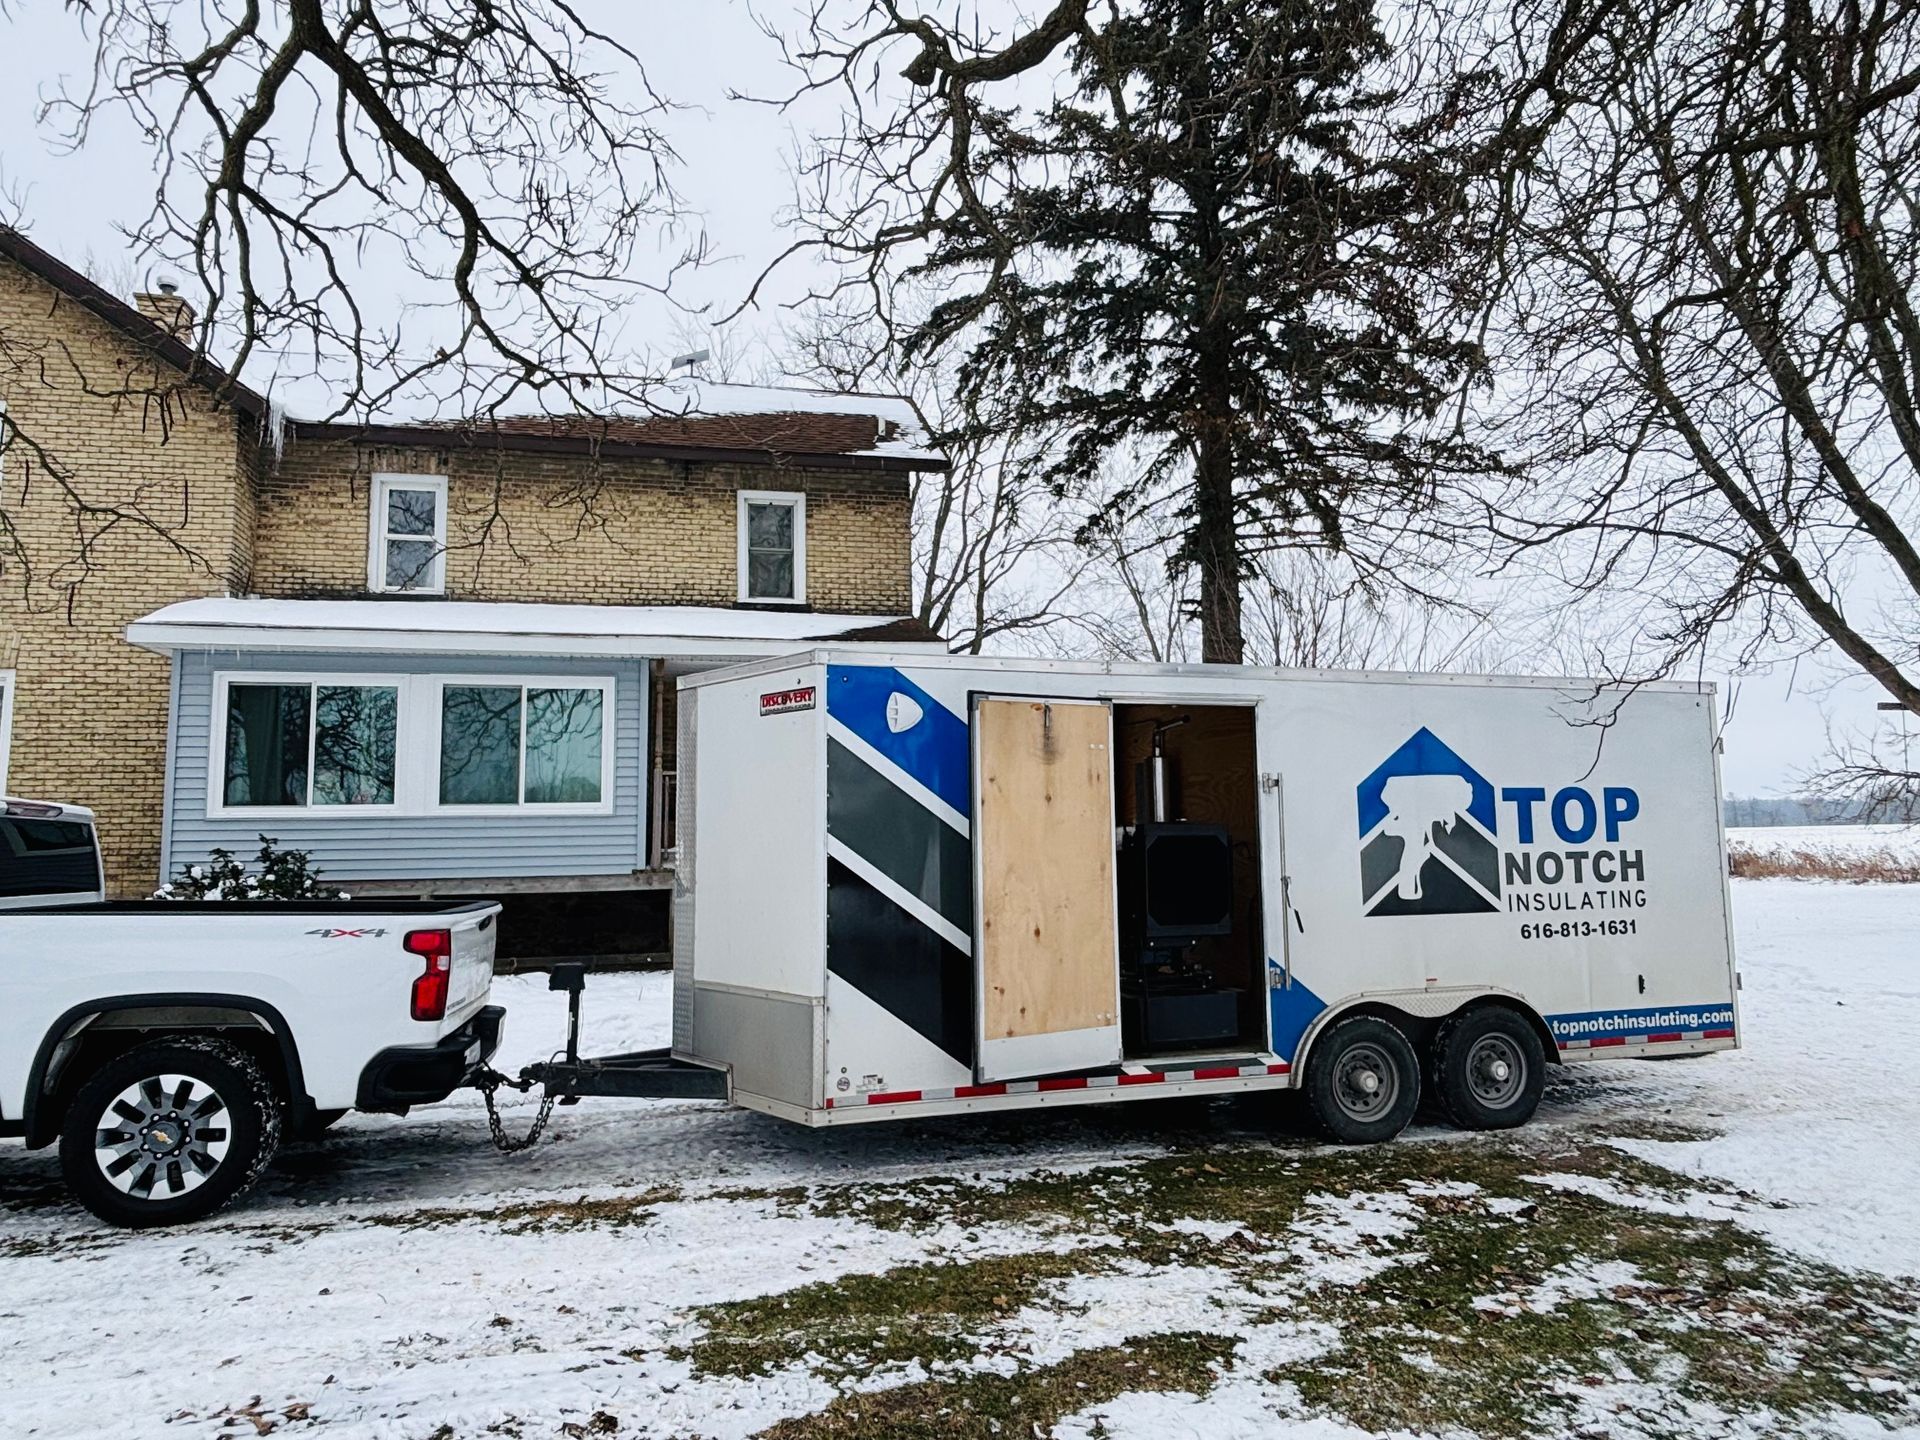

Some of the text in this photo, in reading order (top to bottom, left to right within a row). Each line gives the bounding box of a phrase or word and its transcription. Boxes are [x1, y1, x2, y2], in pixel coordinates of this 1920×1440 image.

[762, 689, 814, 708] DISCOVERY
[1501, 786, 1640, 845] TOP
[1504, 849, 1645, 886] NOTCH
[1508, 889, 1647, 912] INSULATING
[1520, 919, 1637, 940] 616-813-1631
[1552, 1010, 1733, 1037] topnotchinsulating.com
